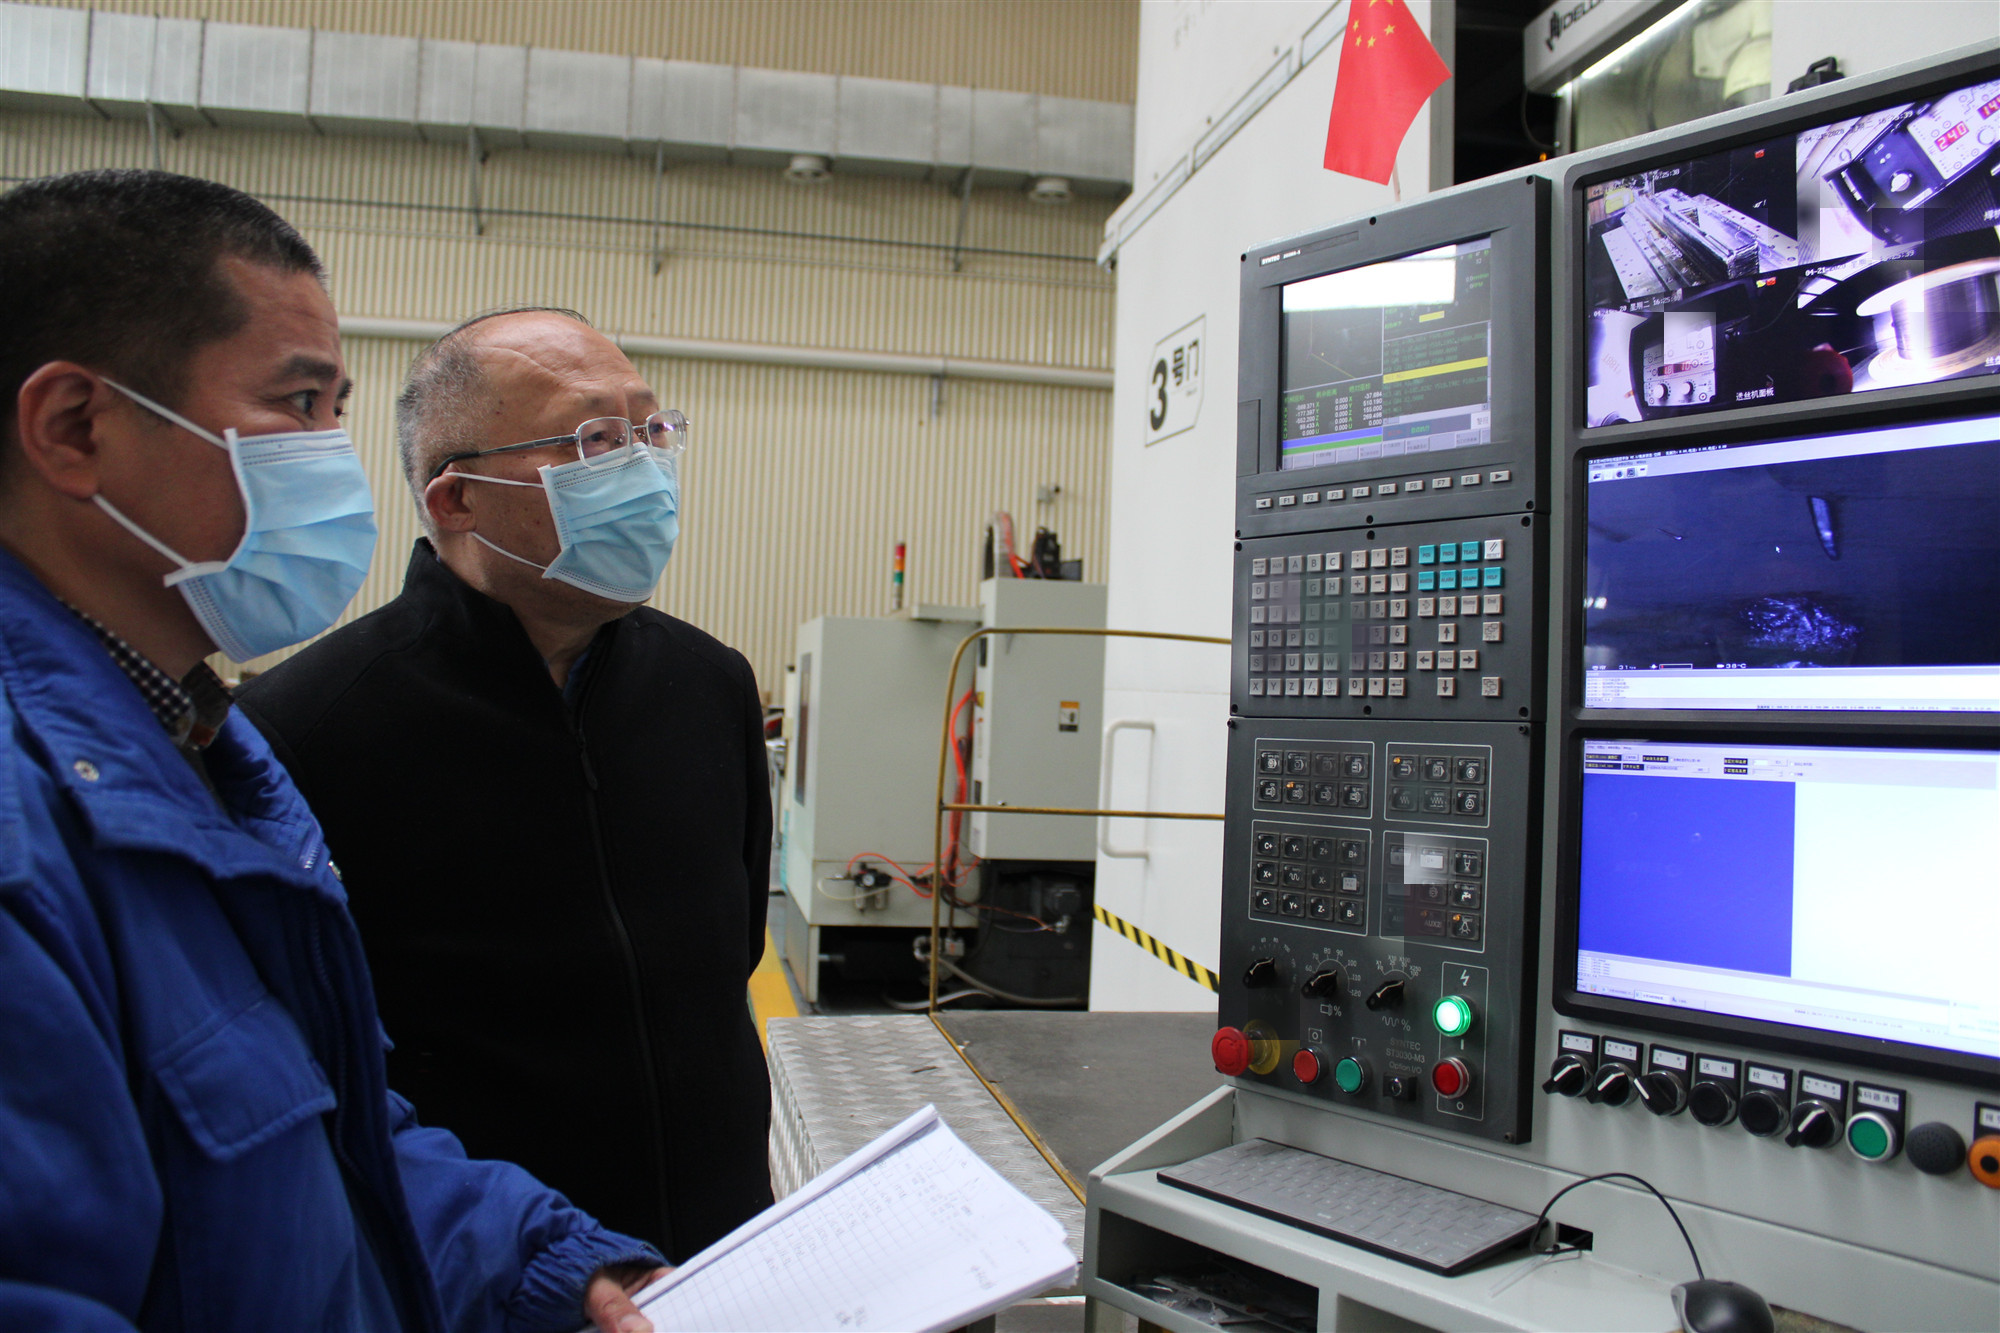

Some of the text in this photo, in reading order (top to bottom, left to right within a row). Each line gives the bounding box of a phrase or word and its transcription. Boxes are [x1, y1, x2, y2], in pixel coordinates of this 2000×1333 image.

[1936, 122, 1968, 150] 240
[1150, 337, 1199, 431] 3号门
[1264, 842, 1358, 858] C+ Y- Z+ B+
[1263, 870, 1327, 884] X+ X-
[1262, 898, 1270, 906] C-
[1318, 905, 1325, 913] Z-
[1305, 964, 1313, 972] 60
[1323, 947, 1331, 955] 80
[1335, 949, 1344, 957] 90
[1390, 1036, 1421, 1051] SYNTEC
[1388, 1060, 1411, 1071] Option
